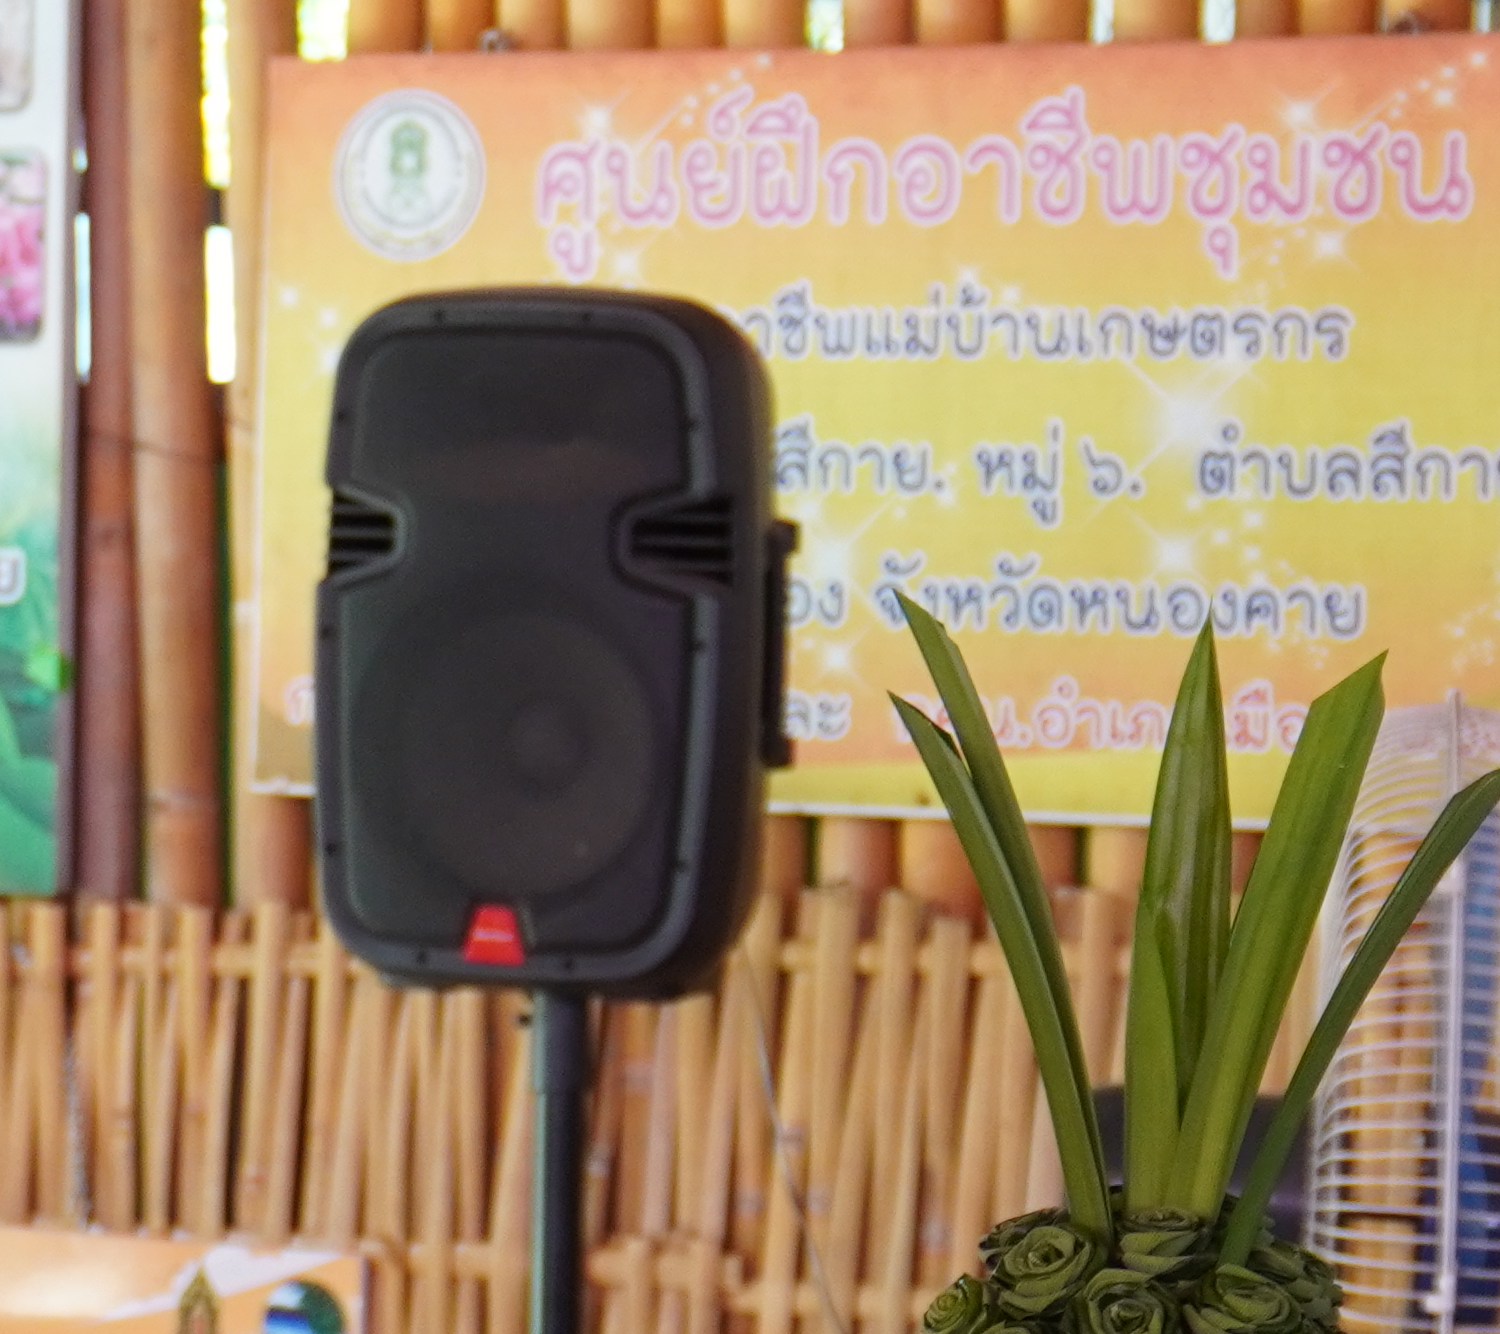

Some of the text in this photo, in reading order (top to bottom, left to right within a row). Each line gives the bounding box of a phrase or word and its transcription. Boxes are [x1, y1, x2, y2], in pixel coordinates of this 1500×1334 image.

[539, 86, 1474, 279] ศูนย์ฝึกอาชีพชุมชน
[744, 277, 1349, 359] าชีพแม่บ้านเกษตรกร
[975, 422, 1061, 526] หมู่
